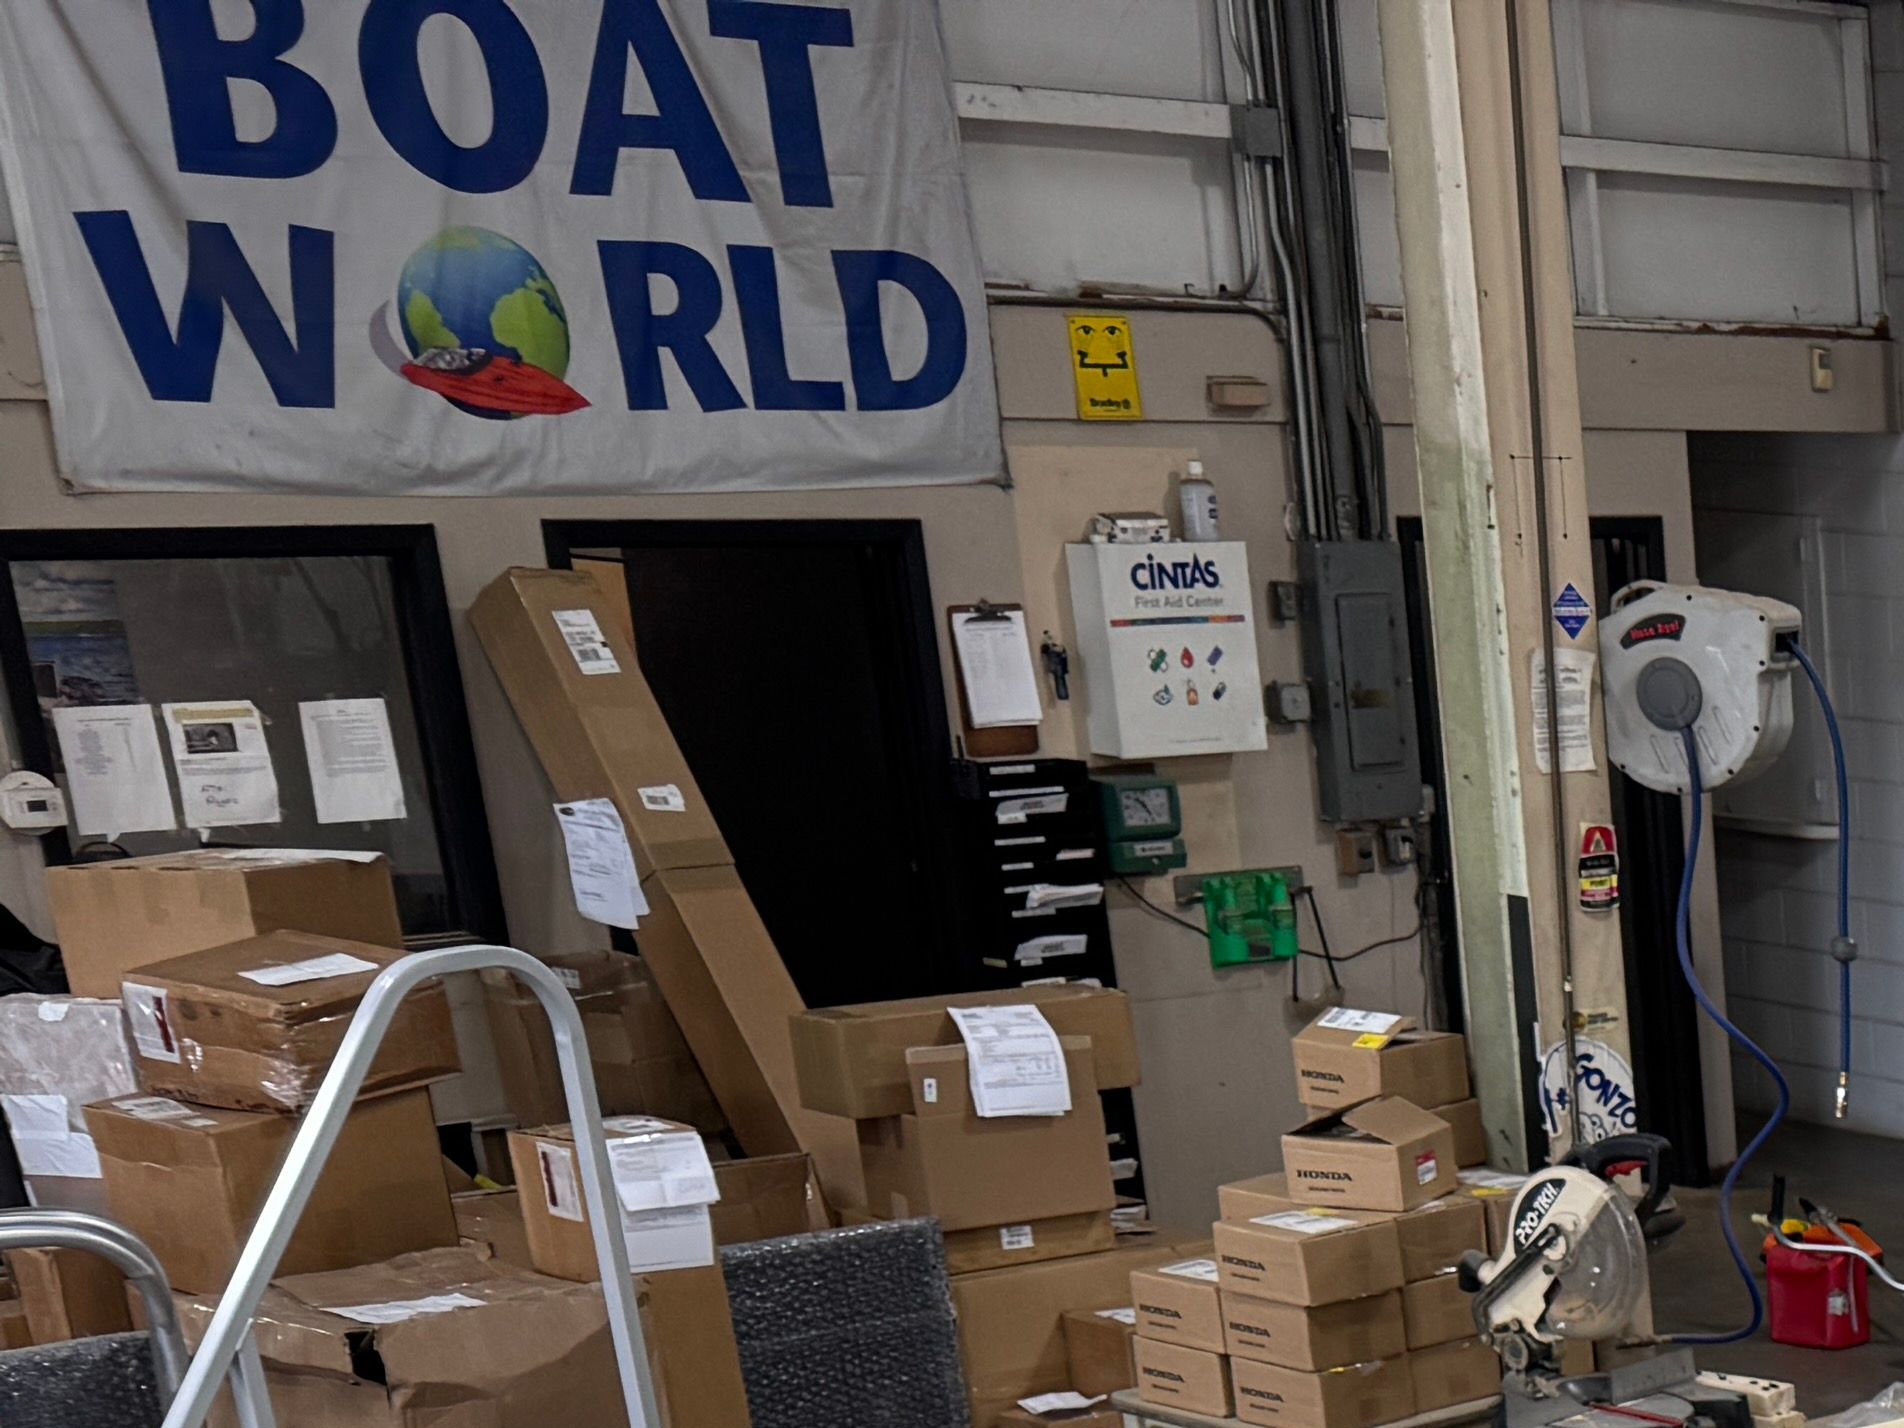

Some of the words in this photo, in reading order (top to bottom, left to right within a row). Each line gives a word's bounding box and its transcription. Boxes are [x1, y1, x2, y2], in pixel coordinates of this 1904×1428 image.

[149, 0, 855, 208] BOAT
[1301, 1068, 1345, 1084] HONDA
[1574, 1053, 1638, 1129] GONZO
[1296, 1169, 1353, 1182] HONDA
[1221, 1254, 1266, 1272] HONDA
[1139, 1303, 1182, 1320] HONDA
[1229, 1321, 1271, 1339] HONDA
[1142, 1366, 1185, 1384] HONDA
[1240, 1385, 1284, 1403] HONDA
